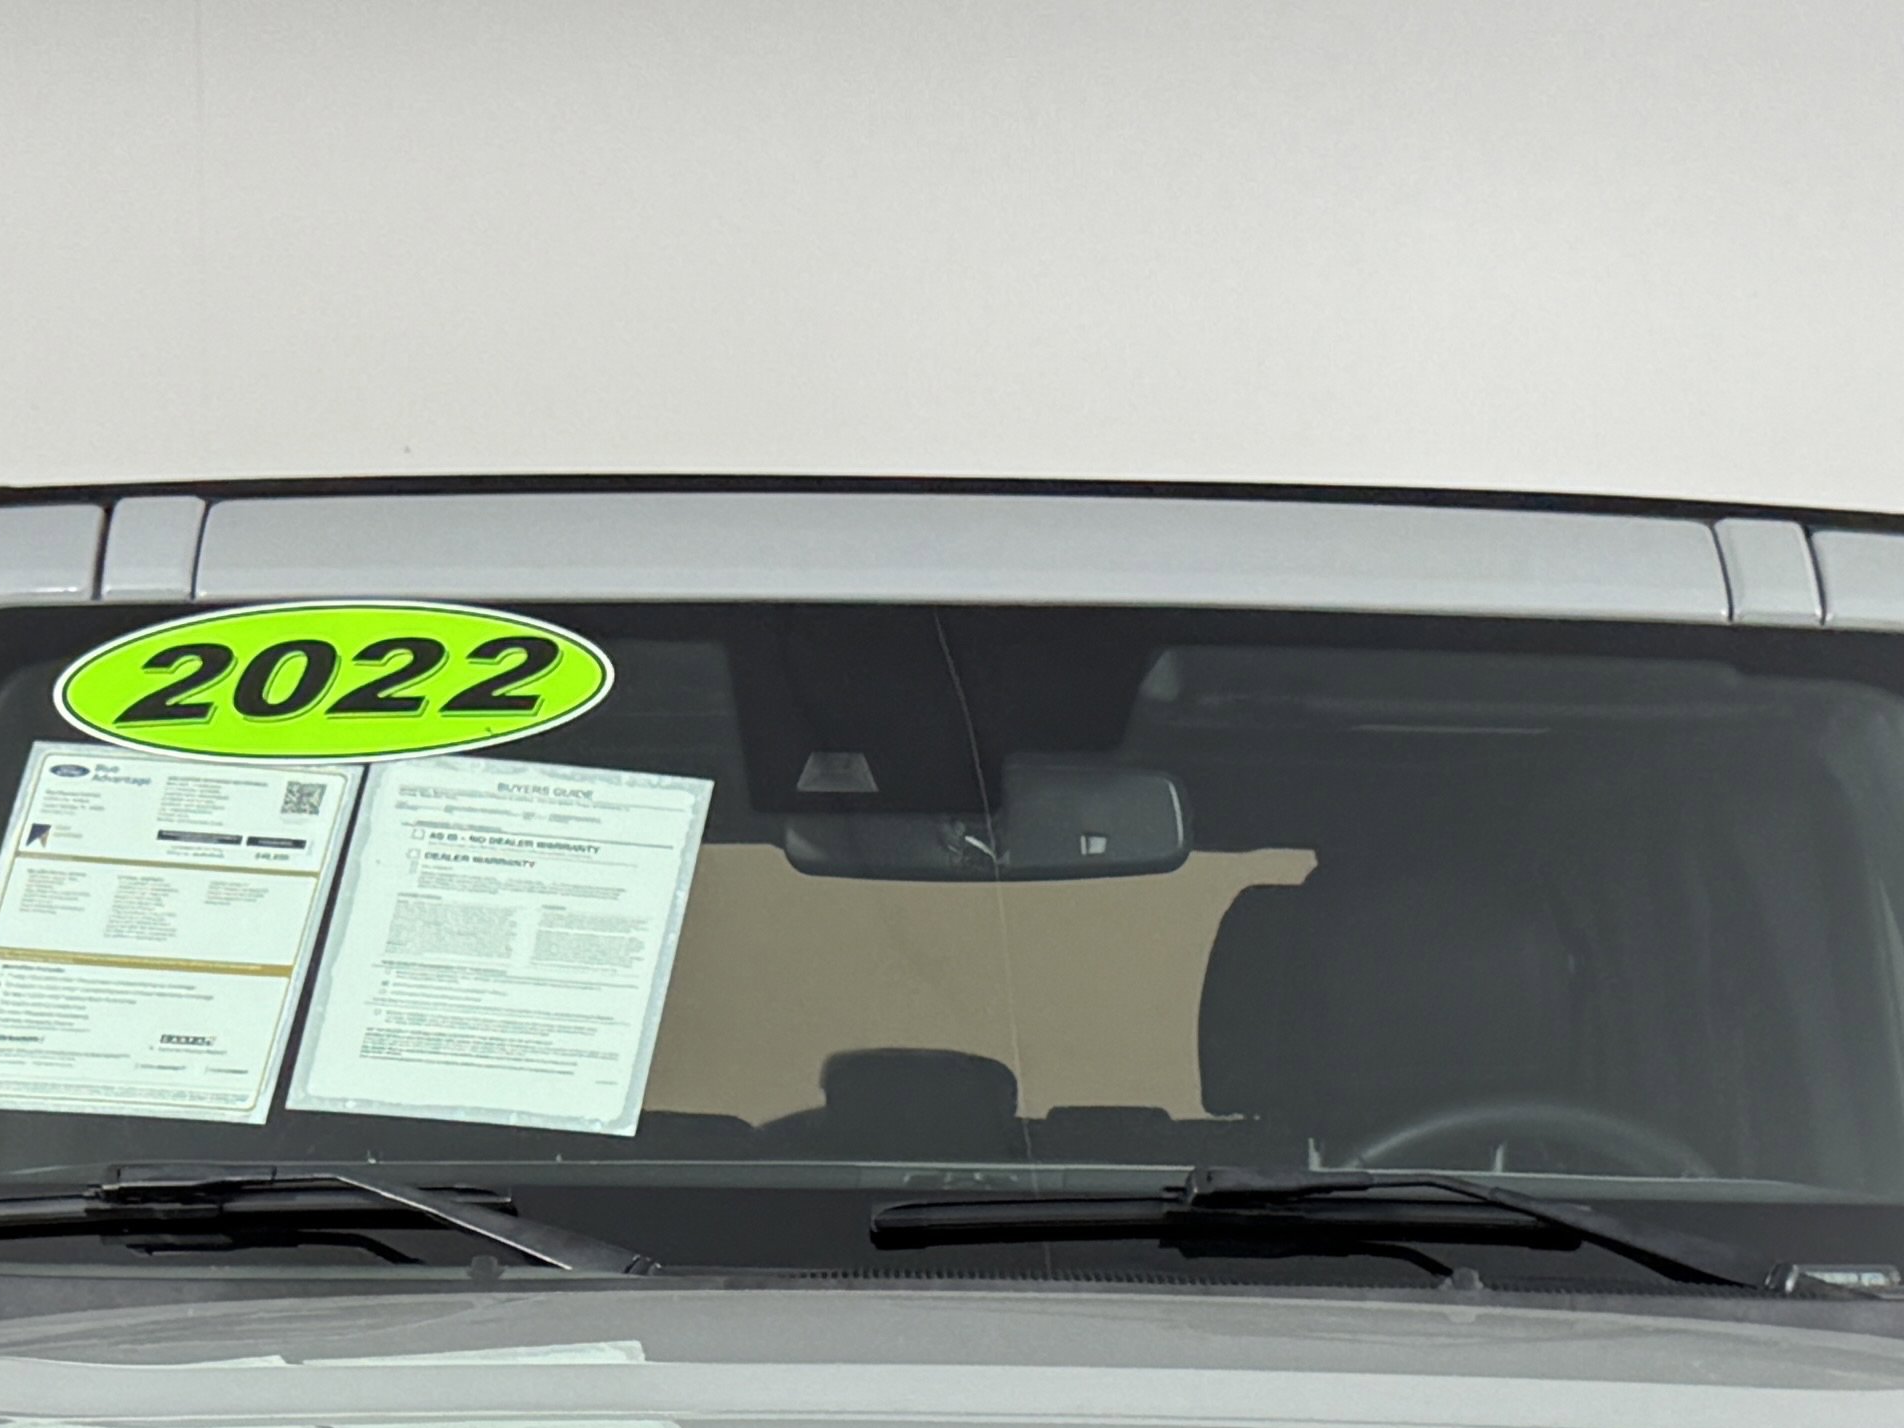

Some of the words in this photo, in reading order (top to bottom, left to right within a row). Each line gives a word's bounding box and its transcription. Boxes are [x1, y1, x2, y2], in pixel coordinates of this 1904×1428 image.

[113, 636, 562, 728] 2022
[92, 774, 152, 787] Advantage
[497, 782, 549, 797] BUYERS
[553, 787, 594, 800] GUIDE
[489, 836, 535, 848] DEALER
[536, 841, 601, 854] WARRANTY
[424, 851, 471, 863] DEALER
[472, 855, 537, 868] WARRANTY
